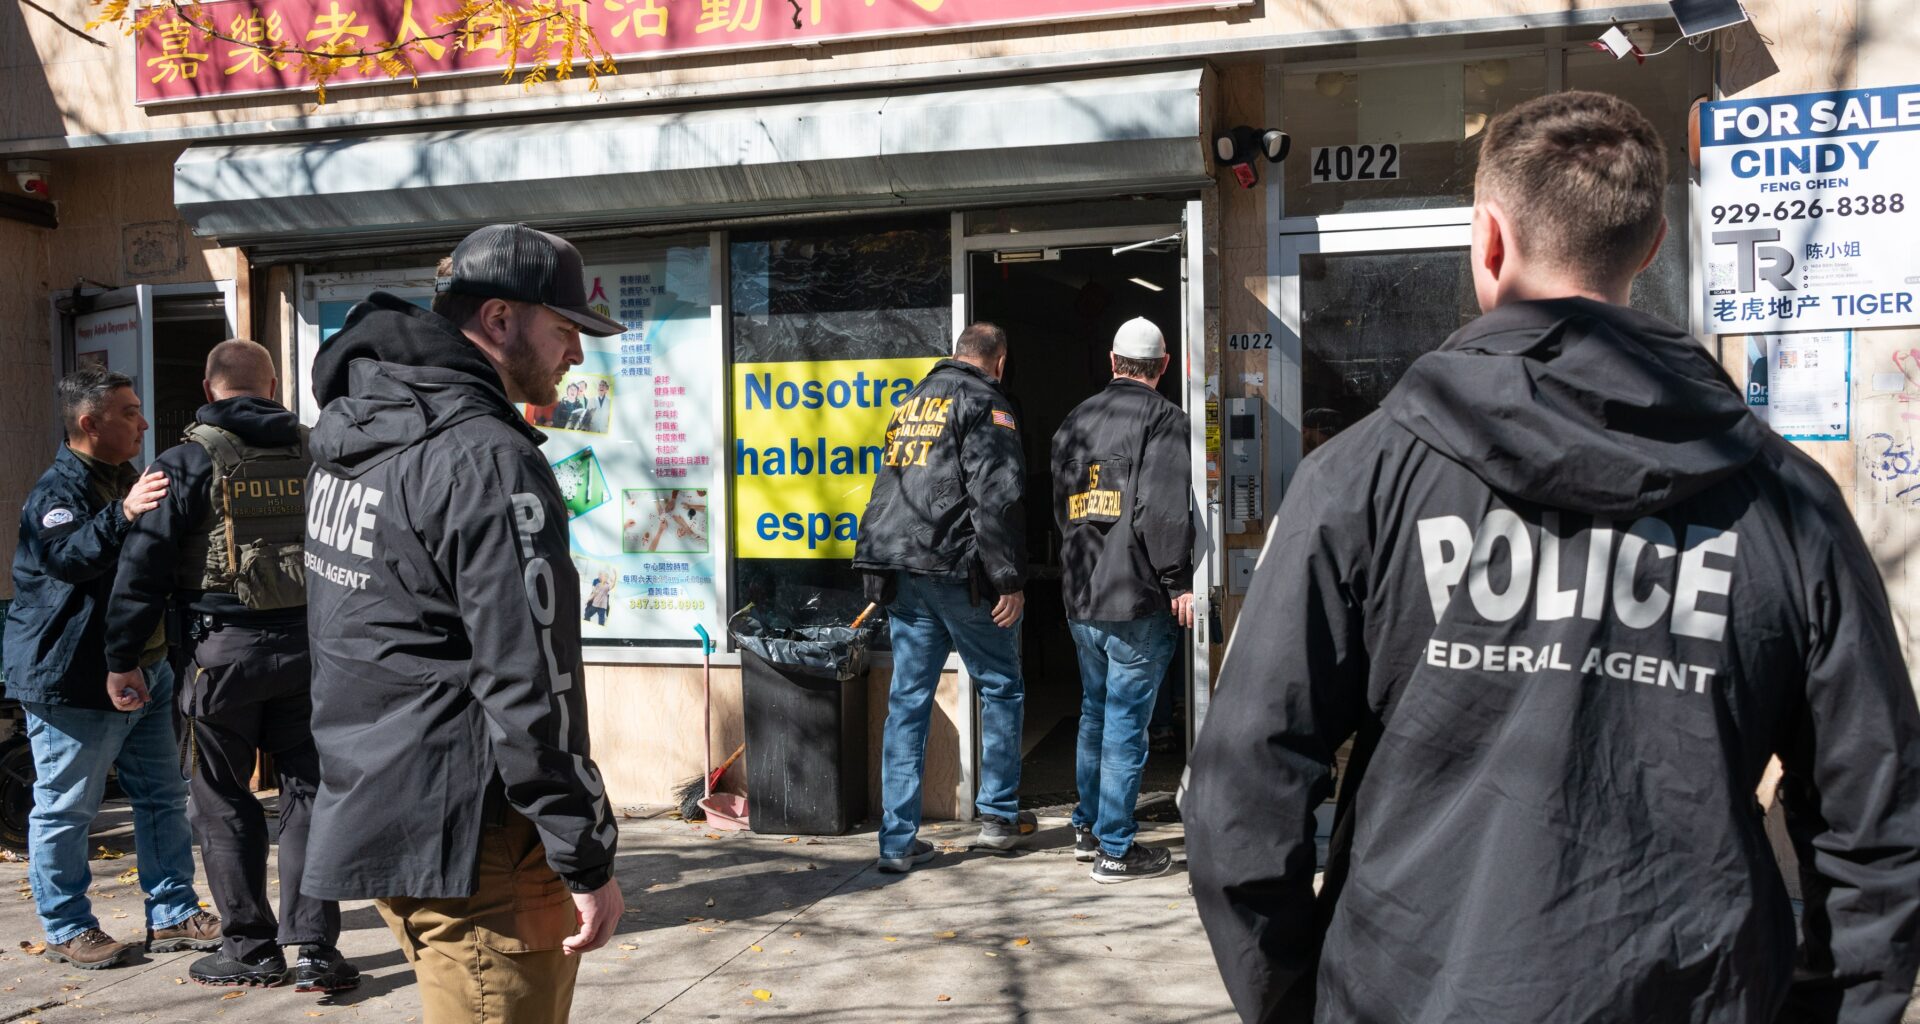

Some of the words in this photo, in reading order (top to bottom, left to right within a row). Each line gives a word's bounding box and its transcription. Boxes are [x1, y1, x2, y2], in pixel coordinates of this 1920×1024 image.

[1713, 103, 1800, 141] FOR
[1810, 92, 1920, 133] SALE
[1314, 144, 1397, 182] 4022
[1731, 140, 1880, 179] CINDY
[1760, 181, 1801, 193] FENG
[1806, 178, 1849, 190] CHEN
[1711, 193, 1905, 225] 929-626-8388
[1806, 241, 1862, 260] 陈小姐
[1713, 295, 1820, 322] 老虎地产
[1832, 292, 1913, 316] TIGER
[1230, 333, 1273, 350] 4022
[745, 371, 915, 410] Nosotra
[234, 479, 304, 498] POLIC
[1088, 489, 1122, 517] GENERAL
[757, 511, 859, 549] espa
[324, 562, 371, 590] AGENT
[1417, 509, 1739, 642] POLICE
[1423, 639, 1572, 673] EDERAL
[1580, 648, 1717, 694] AGENT
[1101, 859, 1128, 872] HOKA
